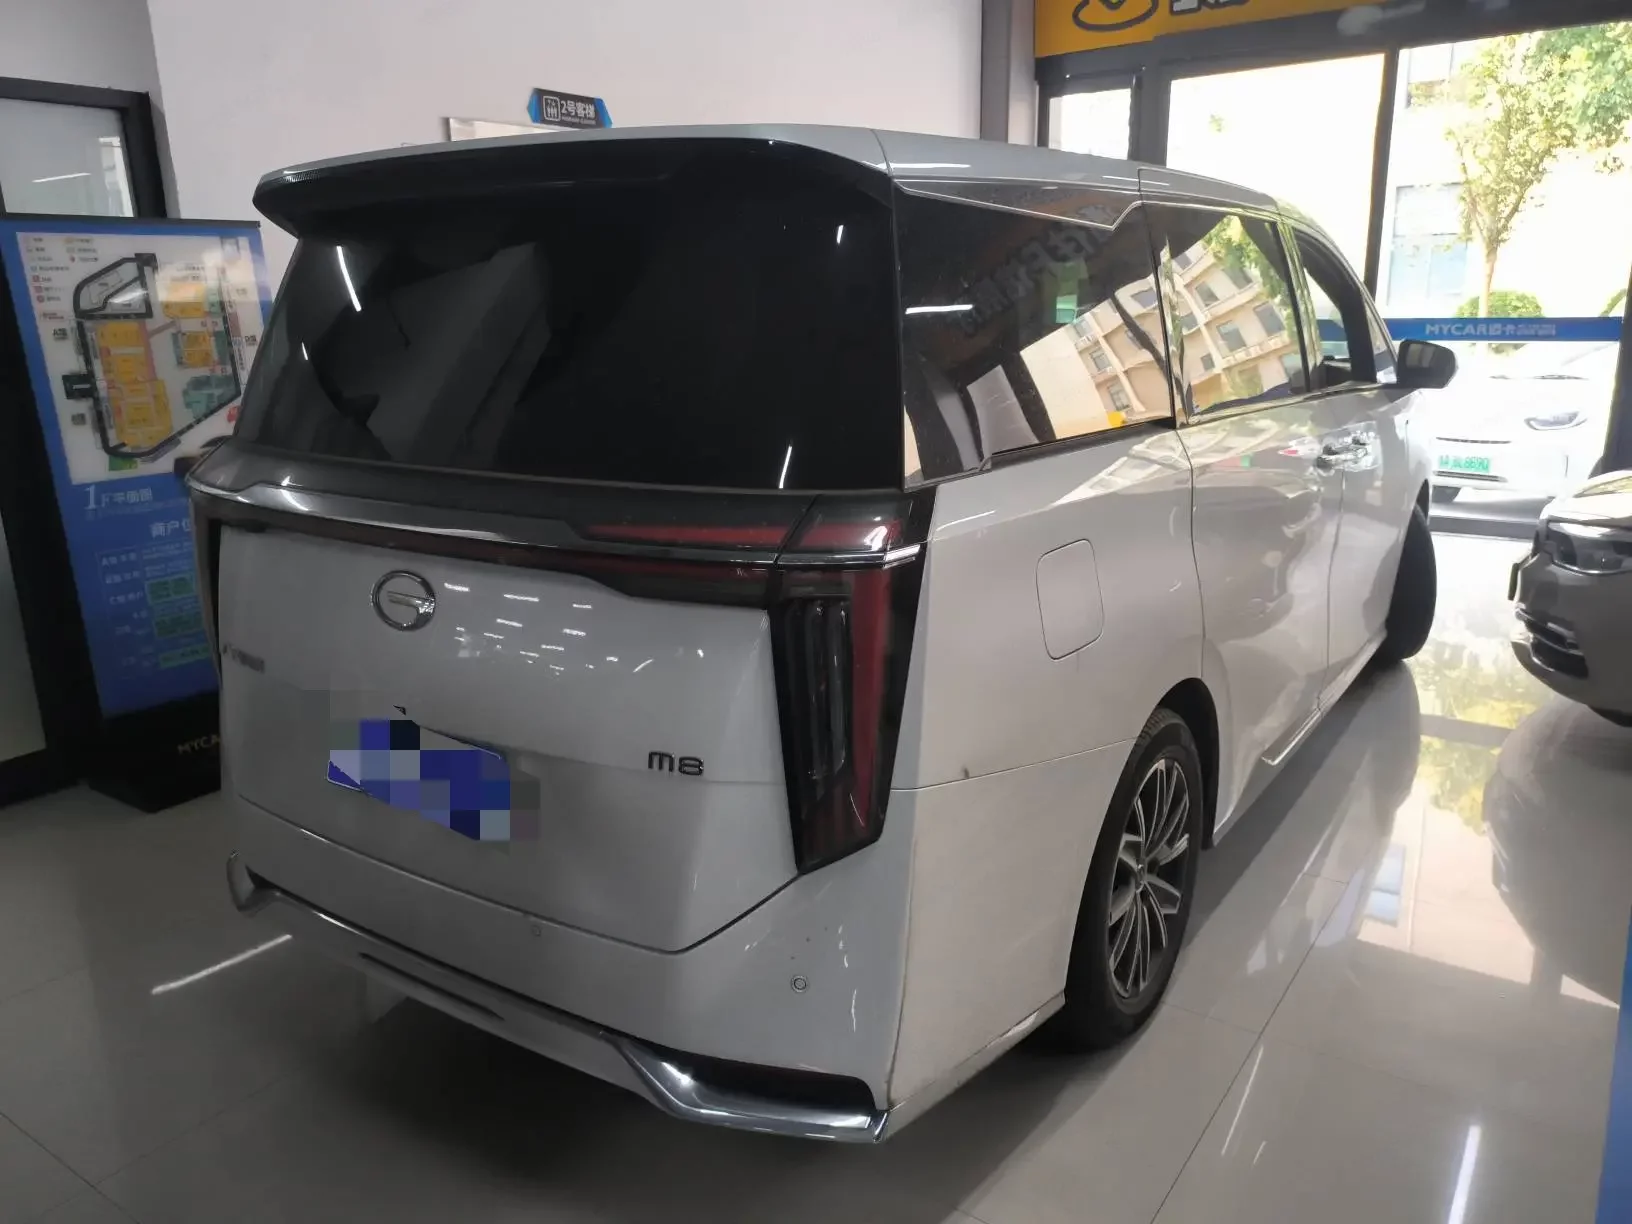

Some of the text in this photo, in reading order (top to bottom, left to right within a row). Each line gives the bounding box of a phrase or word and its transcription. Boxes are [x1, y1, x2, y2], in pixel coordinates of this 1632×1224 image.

[560, 100, 596, 118] 2号客梯
[648, 751, 704, 775] M8
